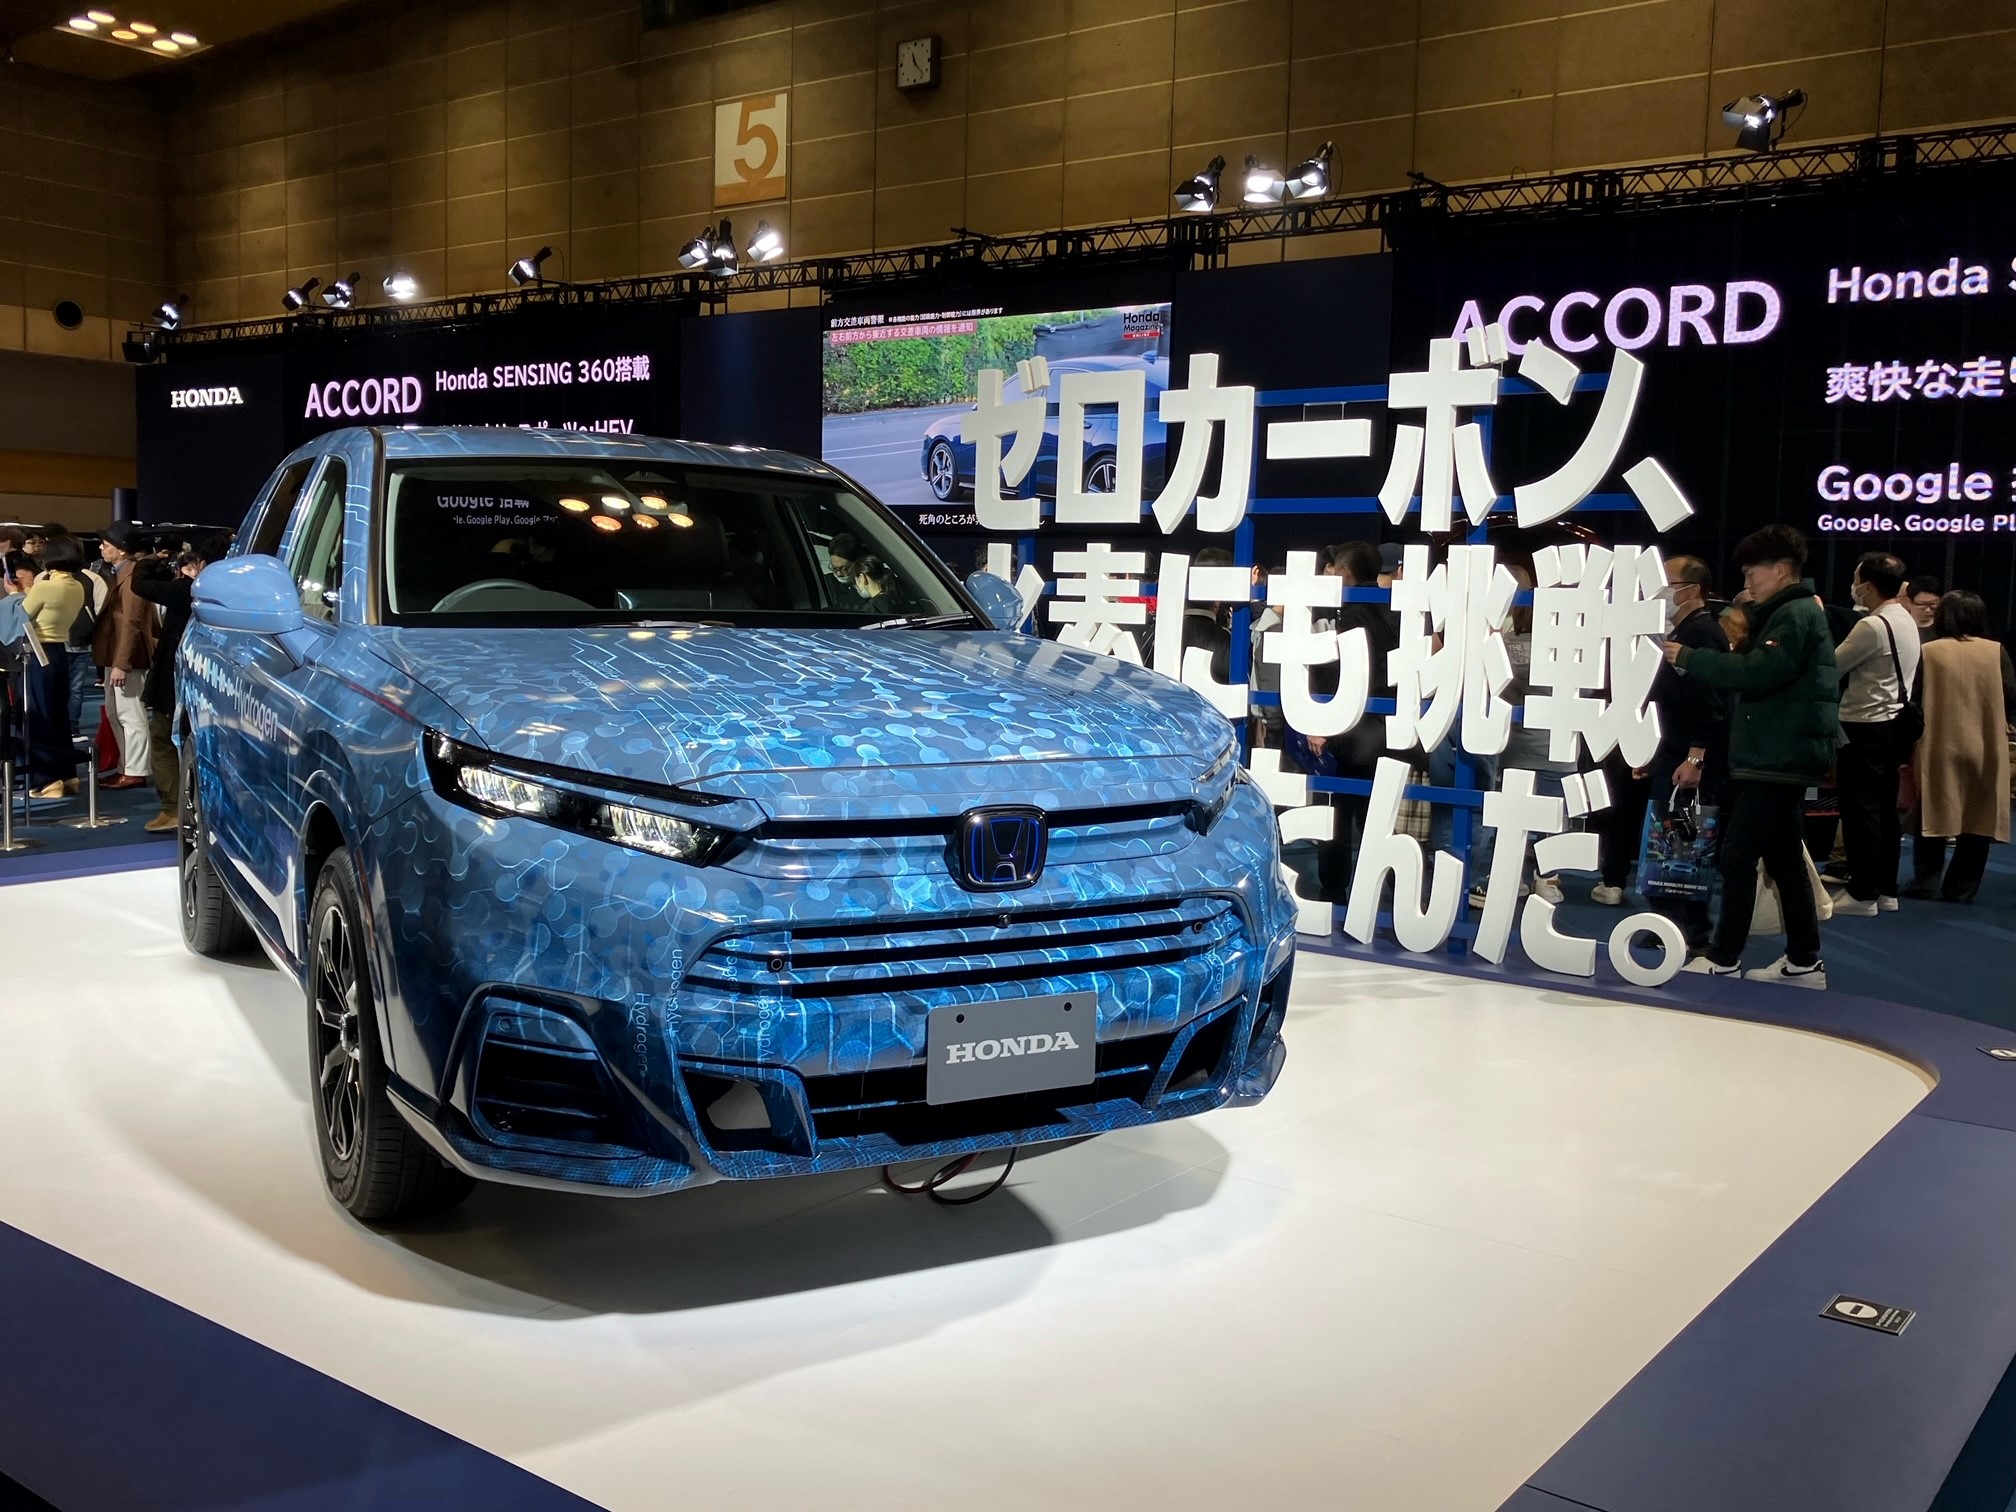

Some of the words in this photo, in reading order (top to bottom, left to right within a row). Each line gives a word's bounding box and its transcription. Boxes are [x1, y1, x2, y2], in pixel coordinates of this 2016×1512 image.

[734, 94, 779, 183] 5
[1827, 257, 1989, 304] Honda
[1123, 311, 1160, 323] Honda
[1451, 280, 1781, 355] ACCORD
[436, 367, 488, 391] Honda
[493, 361, 572, 388] SENSING
[578, 355, 650, 383] 360搭載
[170, 387, 243, 408] HONDA
[304, 376, 422, 418] ACCORD
[961, 322, 1695, 535] ゼロカーボン、
[1817, 462, 1993, 504] Google
[233, 676, 278, 742] Hydrogen
[946, 1031, 1079, 1064] HONDA
